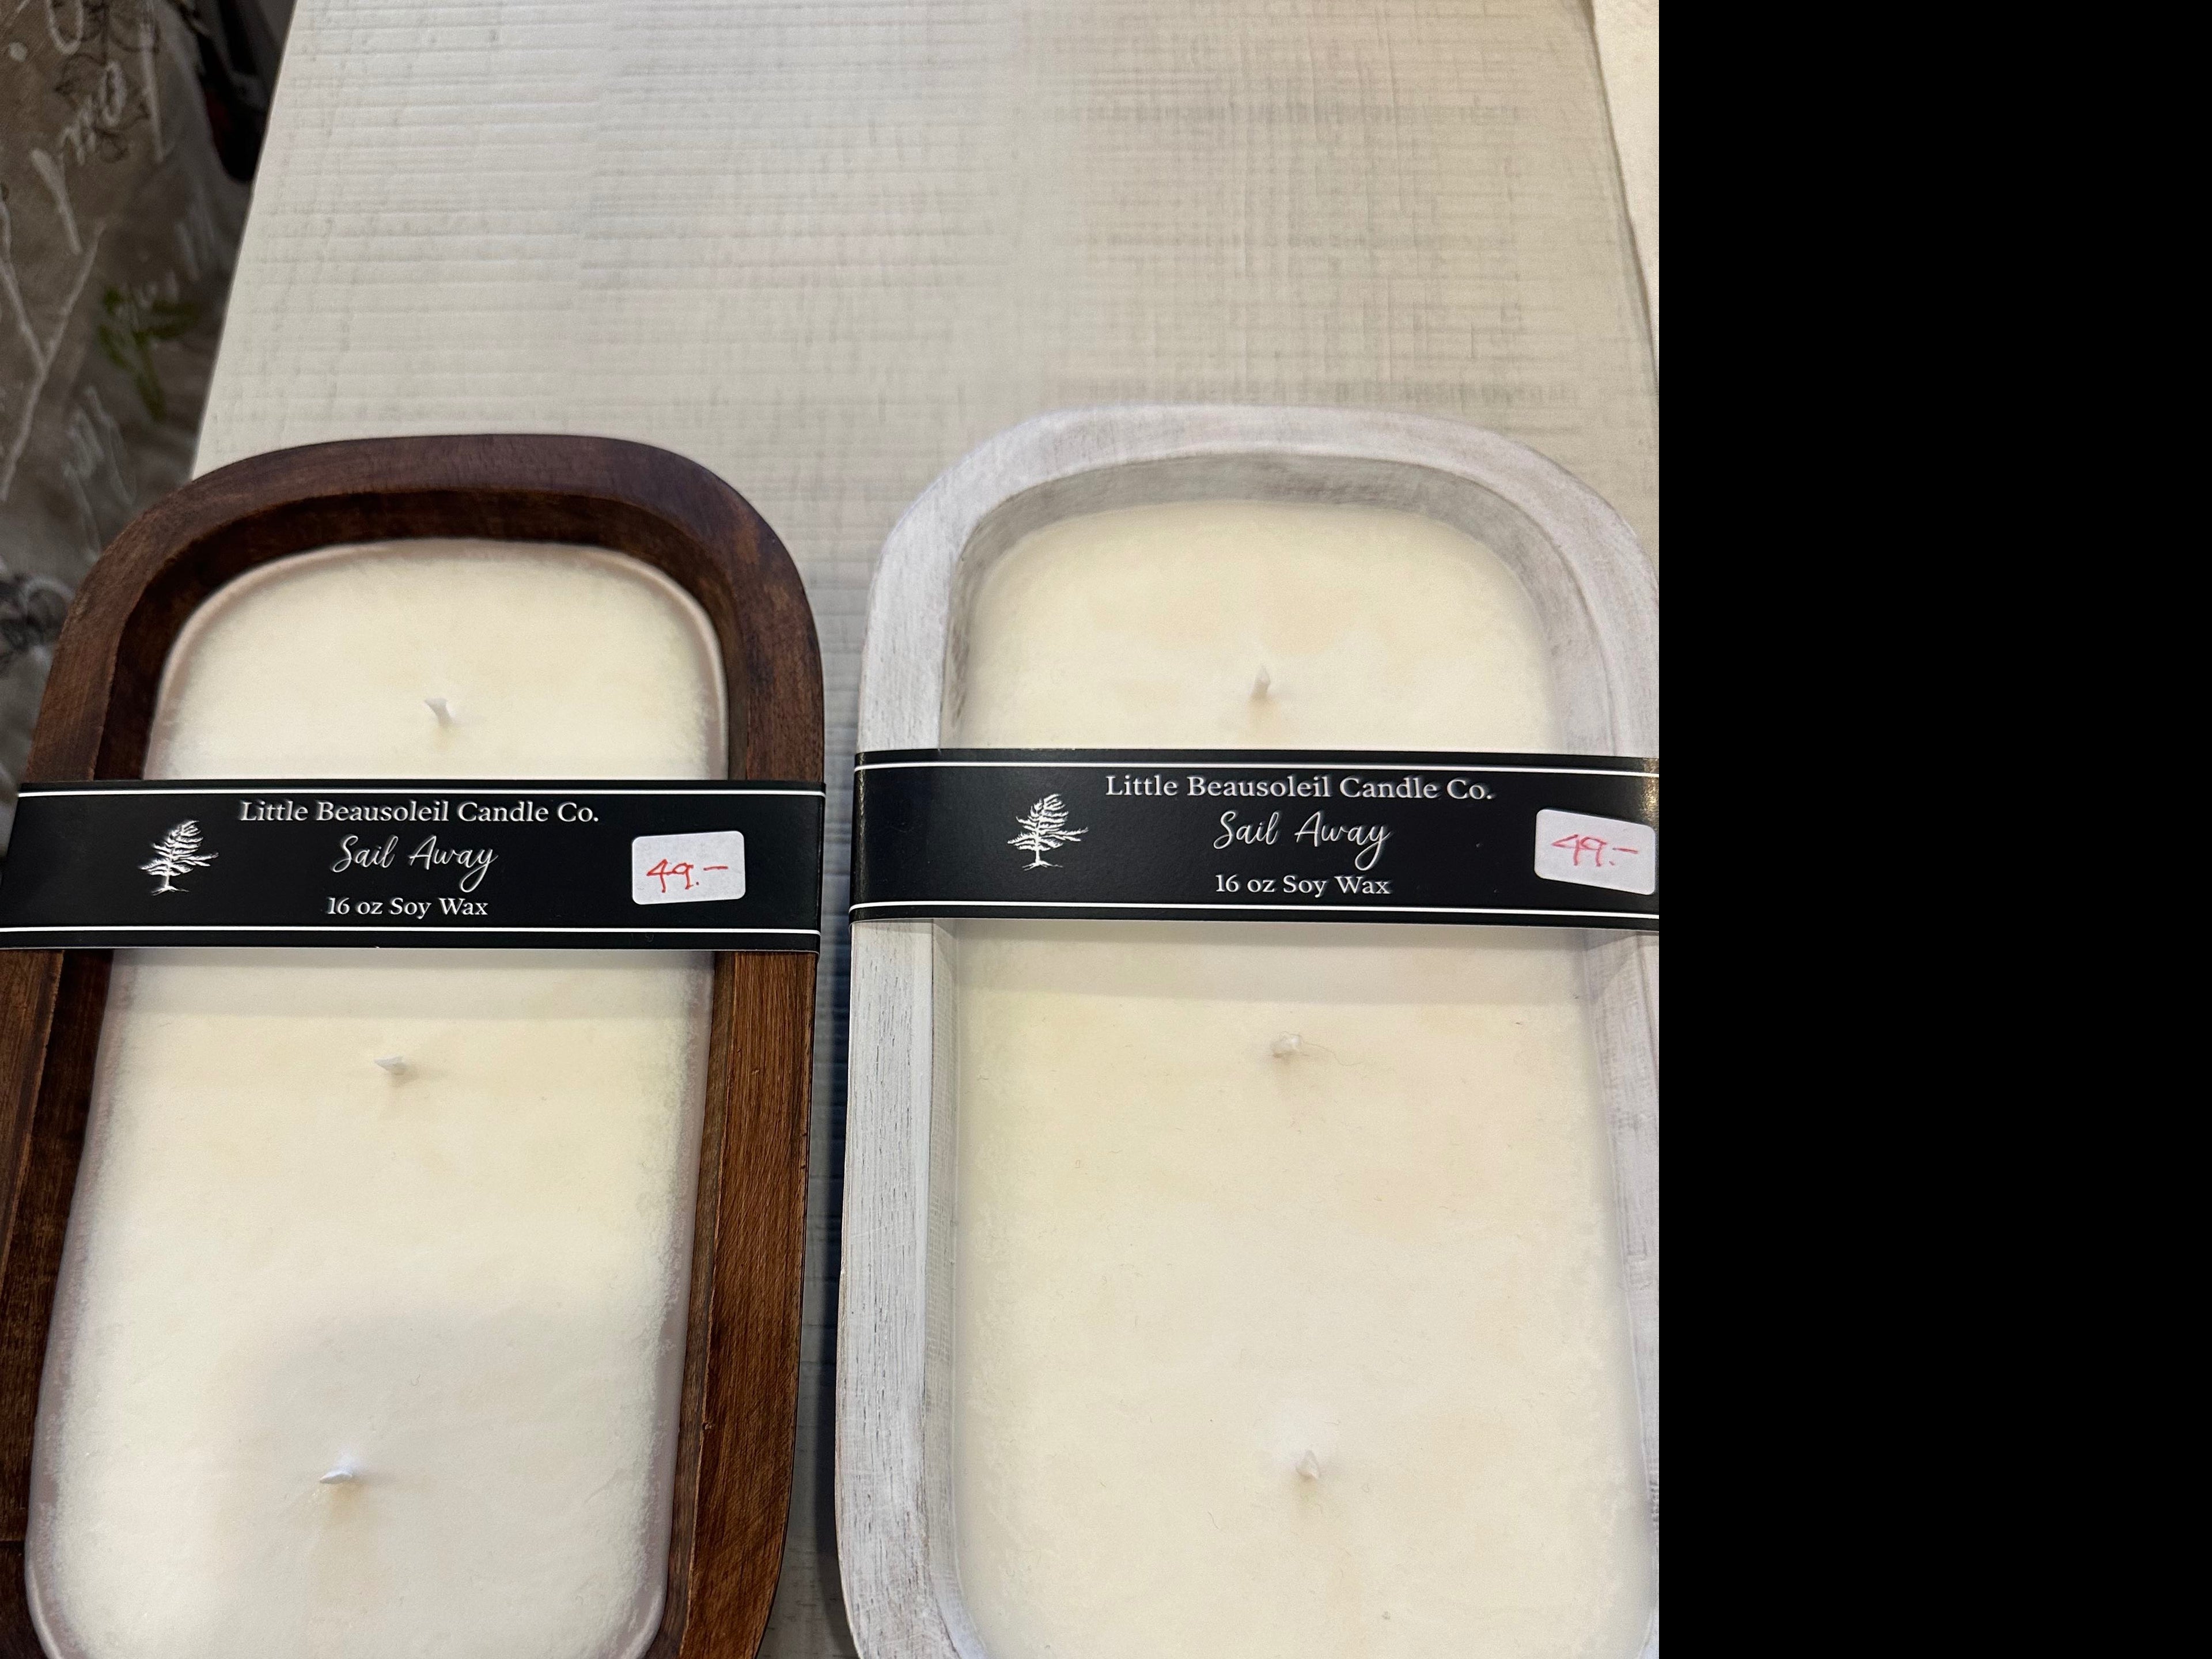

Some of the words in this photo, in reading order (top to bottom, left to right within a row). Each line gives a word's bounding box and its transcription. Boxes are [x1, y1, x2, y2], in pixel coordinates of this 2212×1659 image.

[1105, 774, 1179, 797] Little
[1187, 775, 1331, 798] Beausoleil
[1339, 775, 1440, 799] Candle
[1447, 778, 1496, 800] Co.
[239, 800, 309, 822] Little
[316, 800, 449, 822] Beausoleil
[457, 801, 549, 823] Candle
[556, 801, 600, 823] Co.
[1213, 810, 1280, 850] Sail
[1294, 809, 1393, 872] Away
[330, 835, 399, 873] Sail
[408, 835, 499, 893] Away
[1215, 874, 1240, 893] 16
[1247, 879, 1276, 893] oz
[1282, 874, 1327, 899] Soy
[1334, 876, 1392, 895] Wax
[327, 897, 350, 915] 16
[356, 902, 384, 915] oz
[389, 897, 432, 919] Soy
[439, 897, 488, 916] Wax
